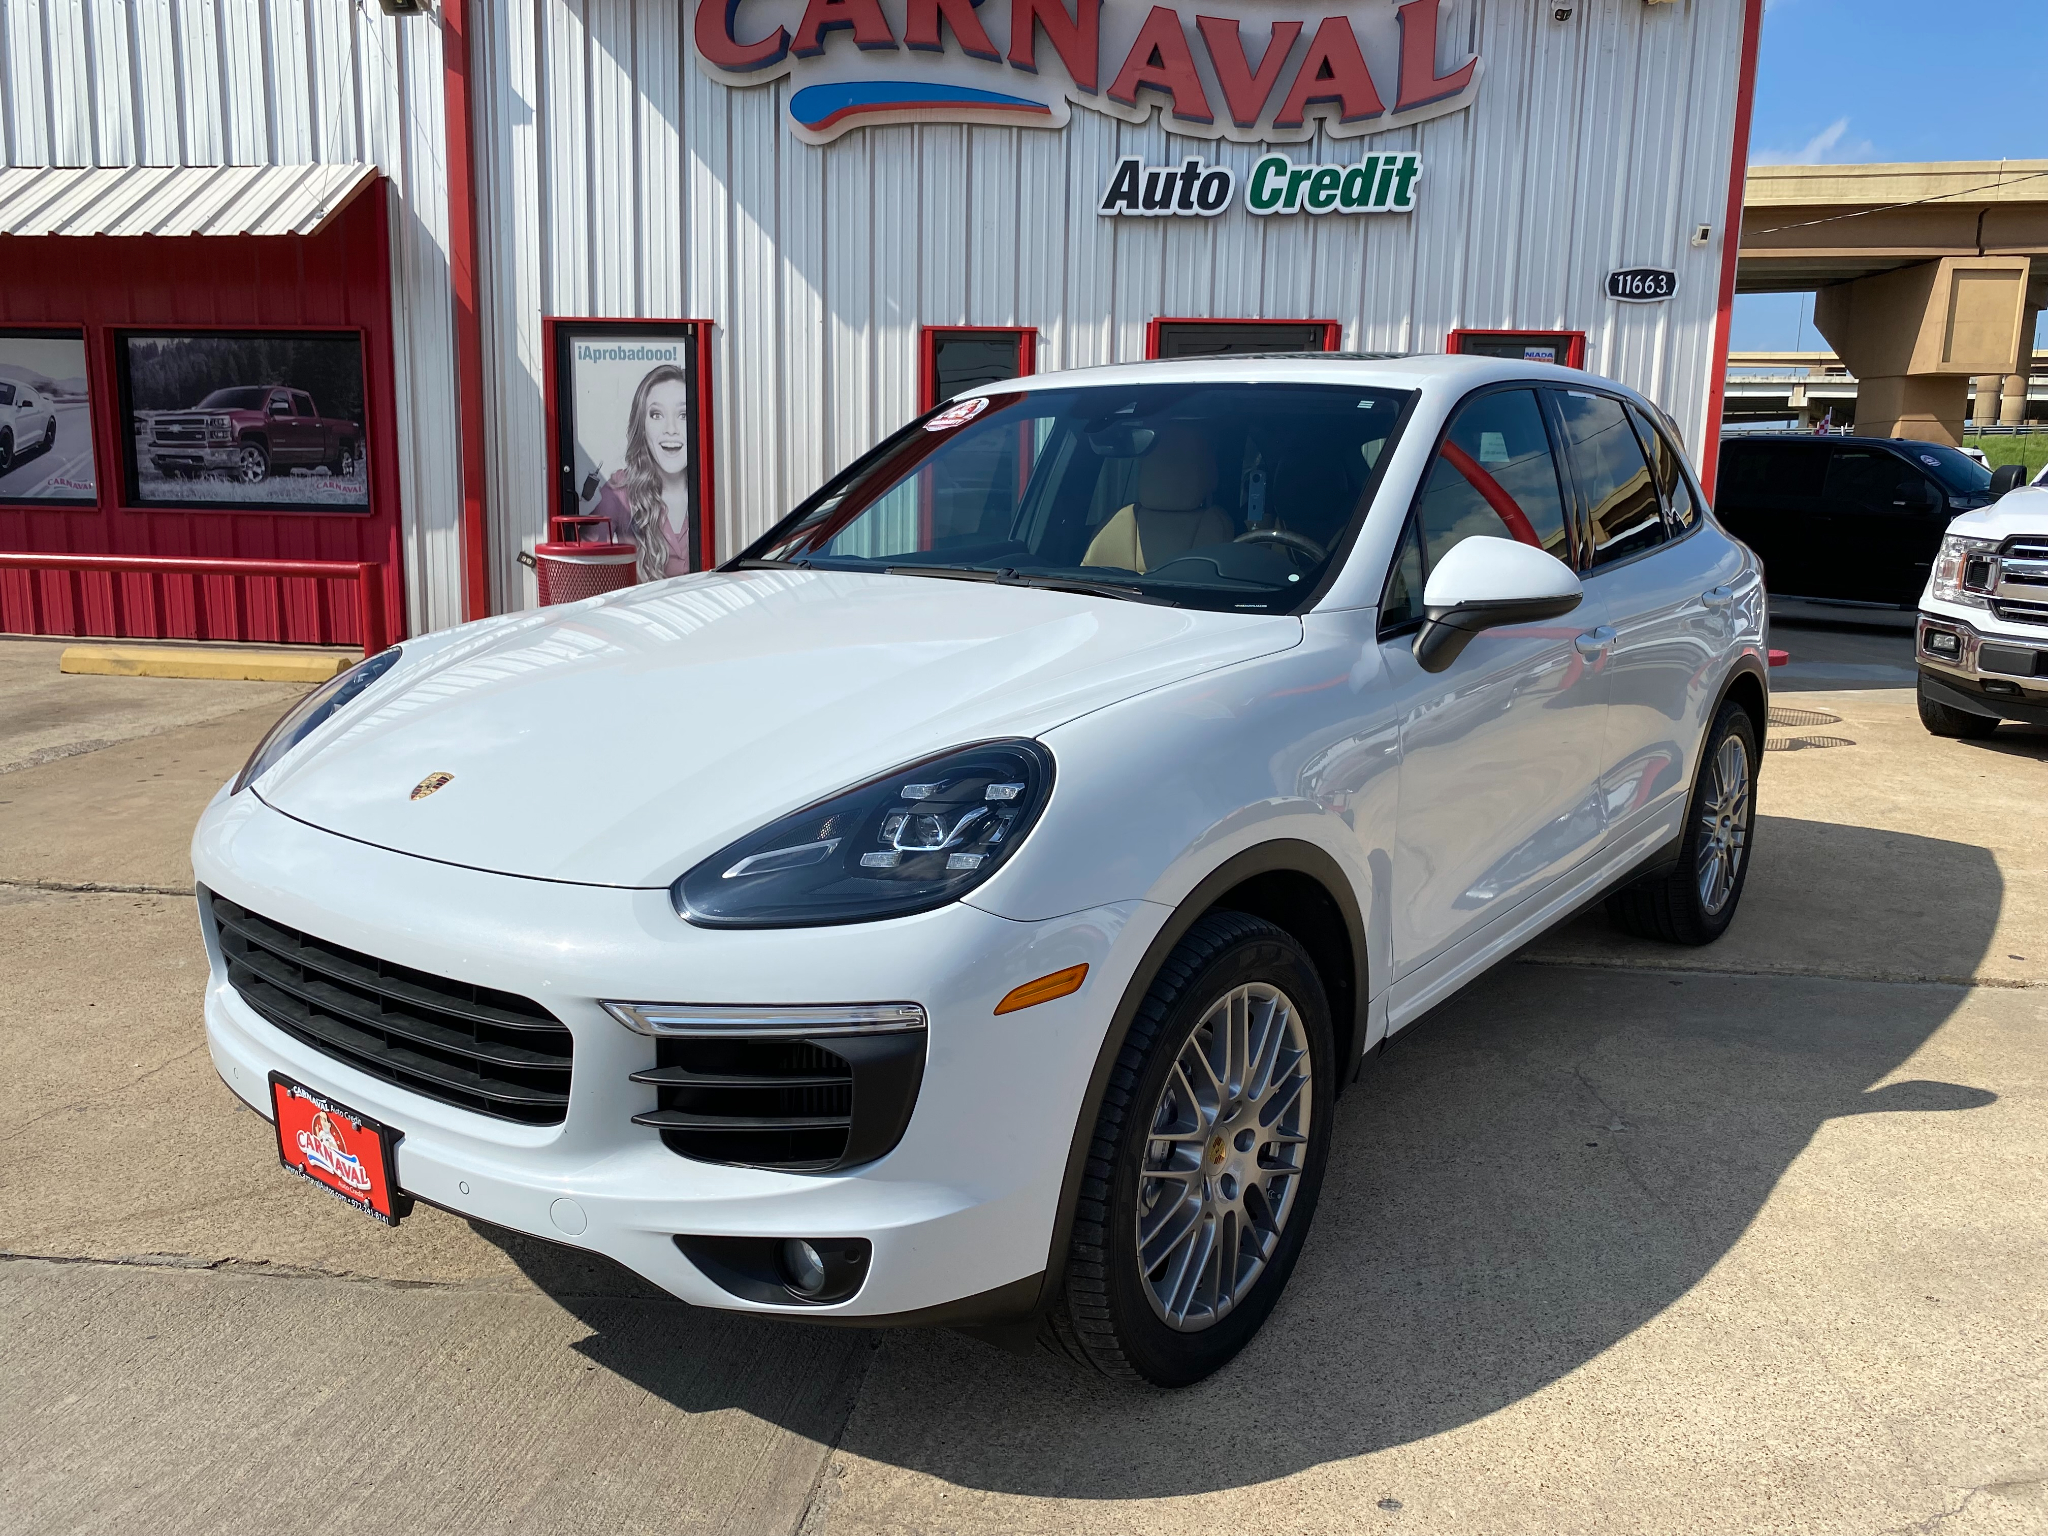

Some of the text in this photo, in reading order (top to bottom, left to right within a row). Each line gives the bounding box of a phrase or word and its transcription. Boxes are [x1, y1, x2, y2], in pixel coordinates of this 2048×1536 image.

[1100, 156, 1420, 211] Auto Credit
[1617, 274, 1667, 294] 11663
[577, 345, 677, 364] ¡Aprobadooo!
[297, 1131, 370, 1185] CARNAVAL
